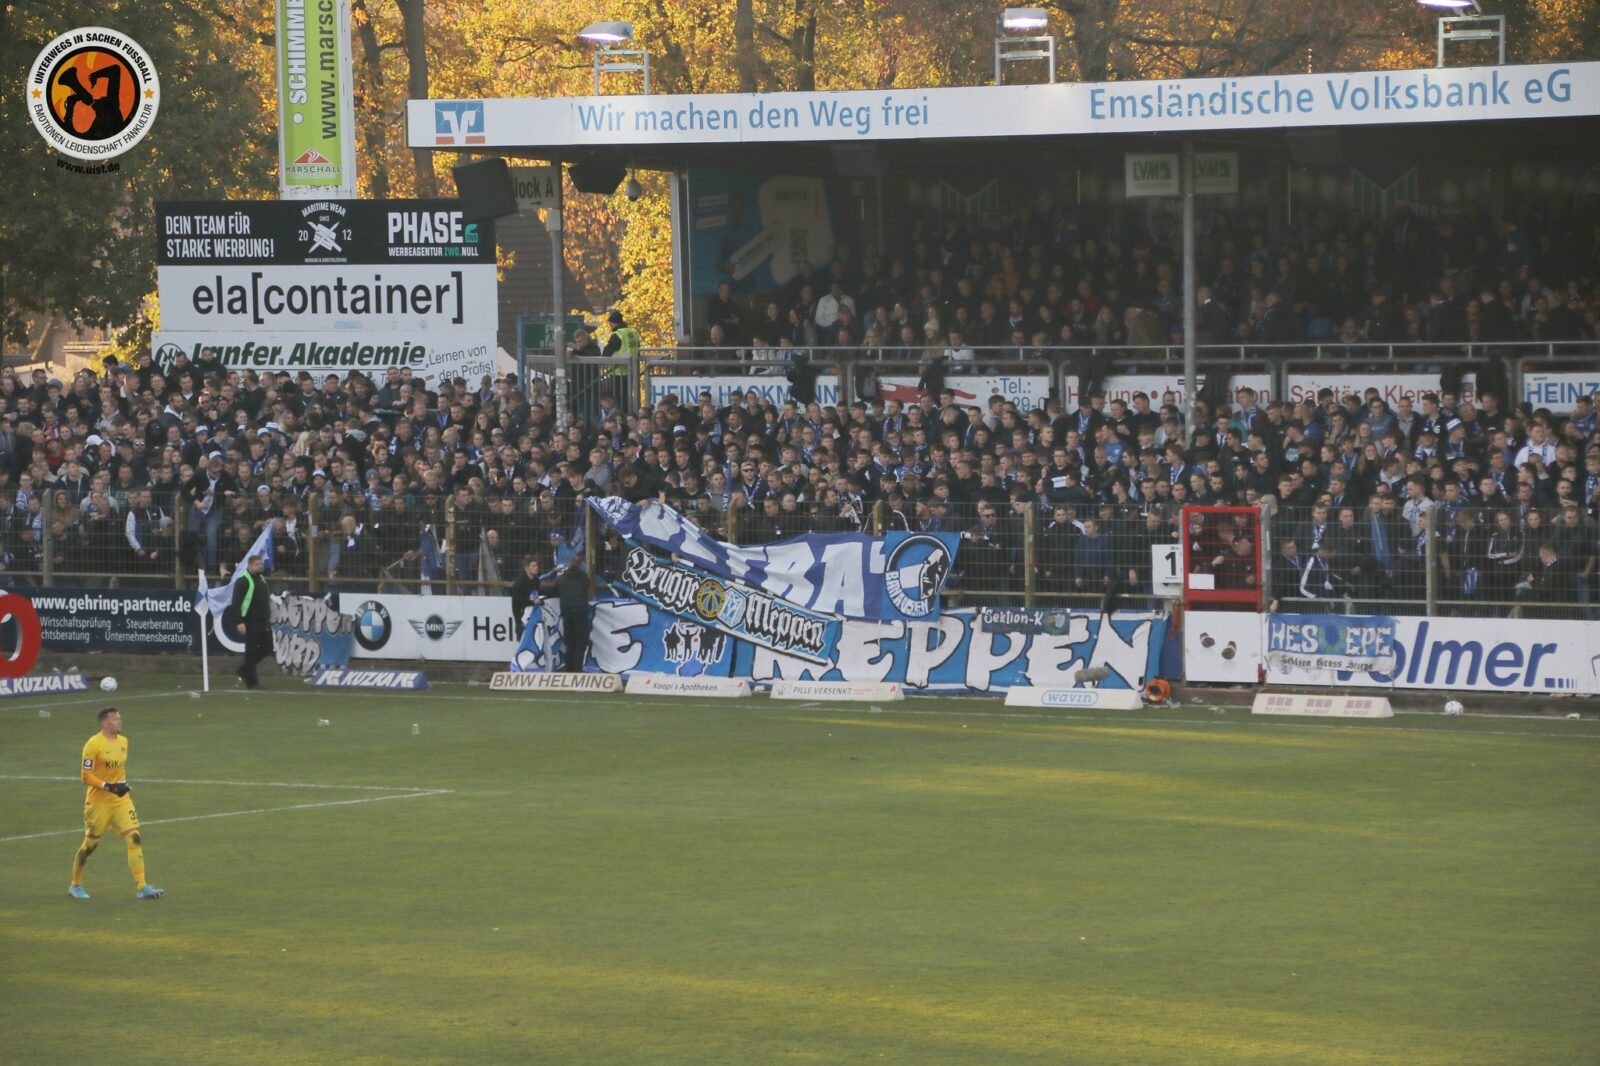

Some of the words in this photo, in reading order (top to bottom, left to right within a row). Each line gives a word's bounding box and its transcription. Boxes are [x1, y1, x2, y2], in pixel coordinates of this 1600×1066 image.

[1090, 79, 1314, 120] Emsländische
[1326, 70, 1510, 111] Volksbank
[1523, 68, 1572, 105] eG
[577, 103, 626, 132] Wir
[634, 101, 739, 131] machen
[748, 100, 800, 129] den
[809, 99, 872, 136] Weg
[881, 96, 930, 127] frei
[286, 165, 342, 174] MARSCHALL
[515, 176, 542, 199] lock
[545, 179, 554, 198] A
[301, 202, 329, 218] MARITIME
[330, 203, 347, 217] WEAR
[165, 215, 191, 235] DEIN
[194, 215, 226, 235] TEAM
[229, 211, 250, 235] FÜR
[387, 211, 464, 244] PHASE
[298, 230, 309, 242] 20
[342, 229, 352, 241] 12
[166, 238, 211, 258] STARKE
[214, 238, 275, 258] WERBUNG!
[388, 247, 443, 256] WERBEAGENTUR
[192, 270, 464, 325] ela[container]
[287, 341, 426, 366] Akademie
[468, 345, 487, 358] von
[461, 361, 495, 378] Profis!
[999, 377, 1031, 394] Tel.:
[1527, 382, 1600, 404] HEINZ
[1164, 551, 1177, 576] 1
[622, 546, 700, 614] Brugge
[31, 594, 192, 614] www.gehring-partner.de
[40, 616, 112, 629] Wirtschaftsprüfung
[125, 618, 184, 632] Steuerberatung
[745, 590, 824, 652] Meppen
[983, 609, 1044, 626] Sektion-K
[426, 623, 443, 633] MINI
[473, 616, 513, 642] Hel
[41, 631, 91, 643] chtsberatung
[104, 630, 193, 646] Unternehmensberatung
[13, 675, 62, 693] KUZKA
[341, 671, 396, 687] KUZKA
[492, 674, 535, 689] BMW
[539, 675, 615, 690] HELMING
[792, 686, 813, 695] PILLE
[814, 686, 853, 696] VERSENKT
[1047, 692, 1093, 704] wavin
